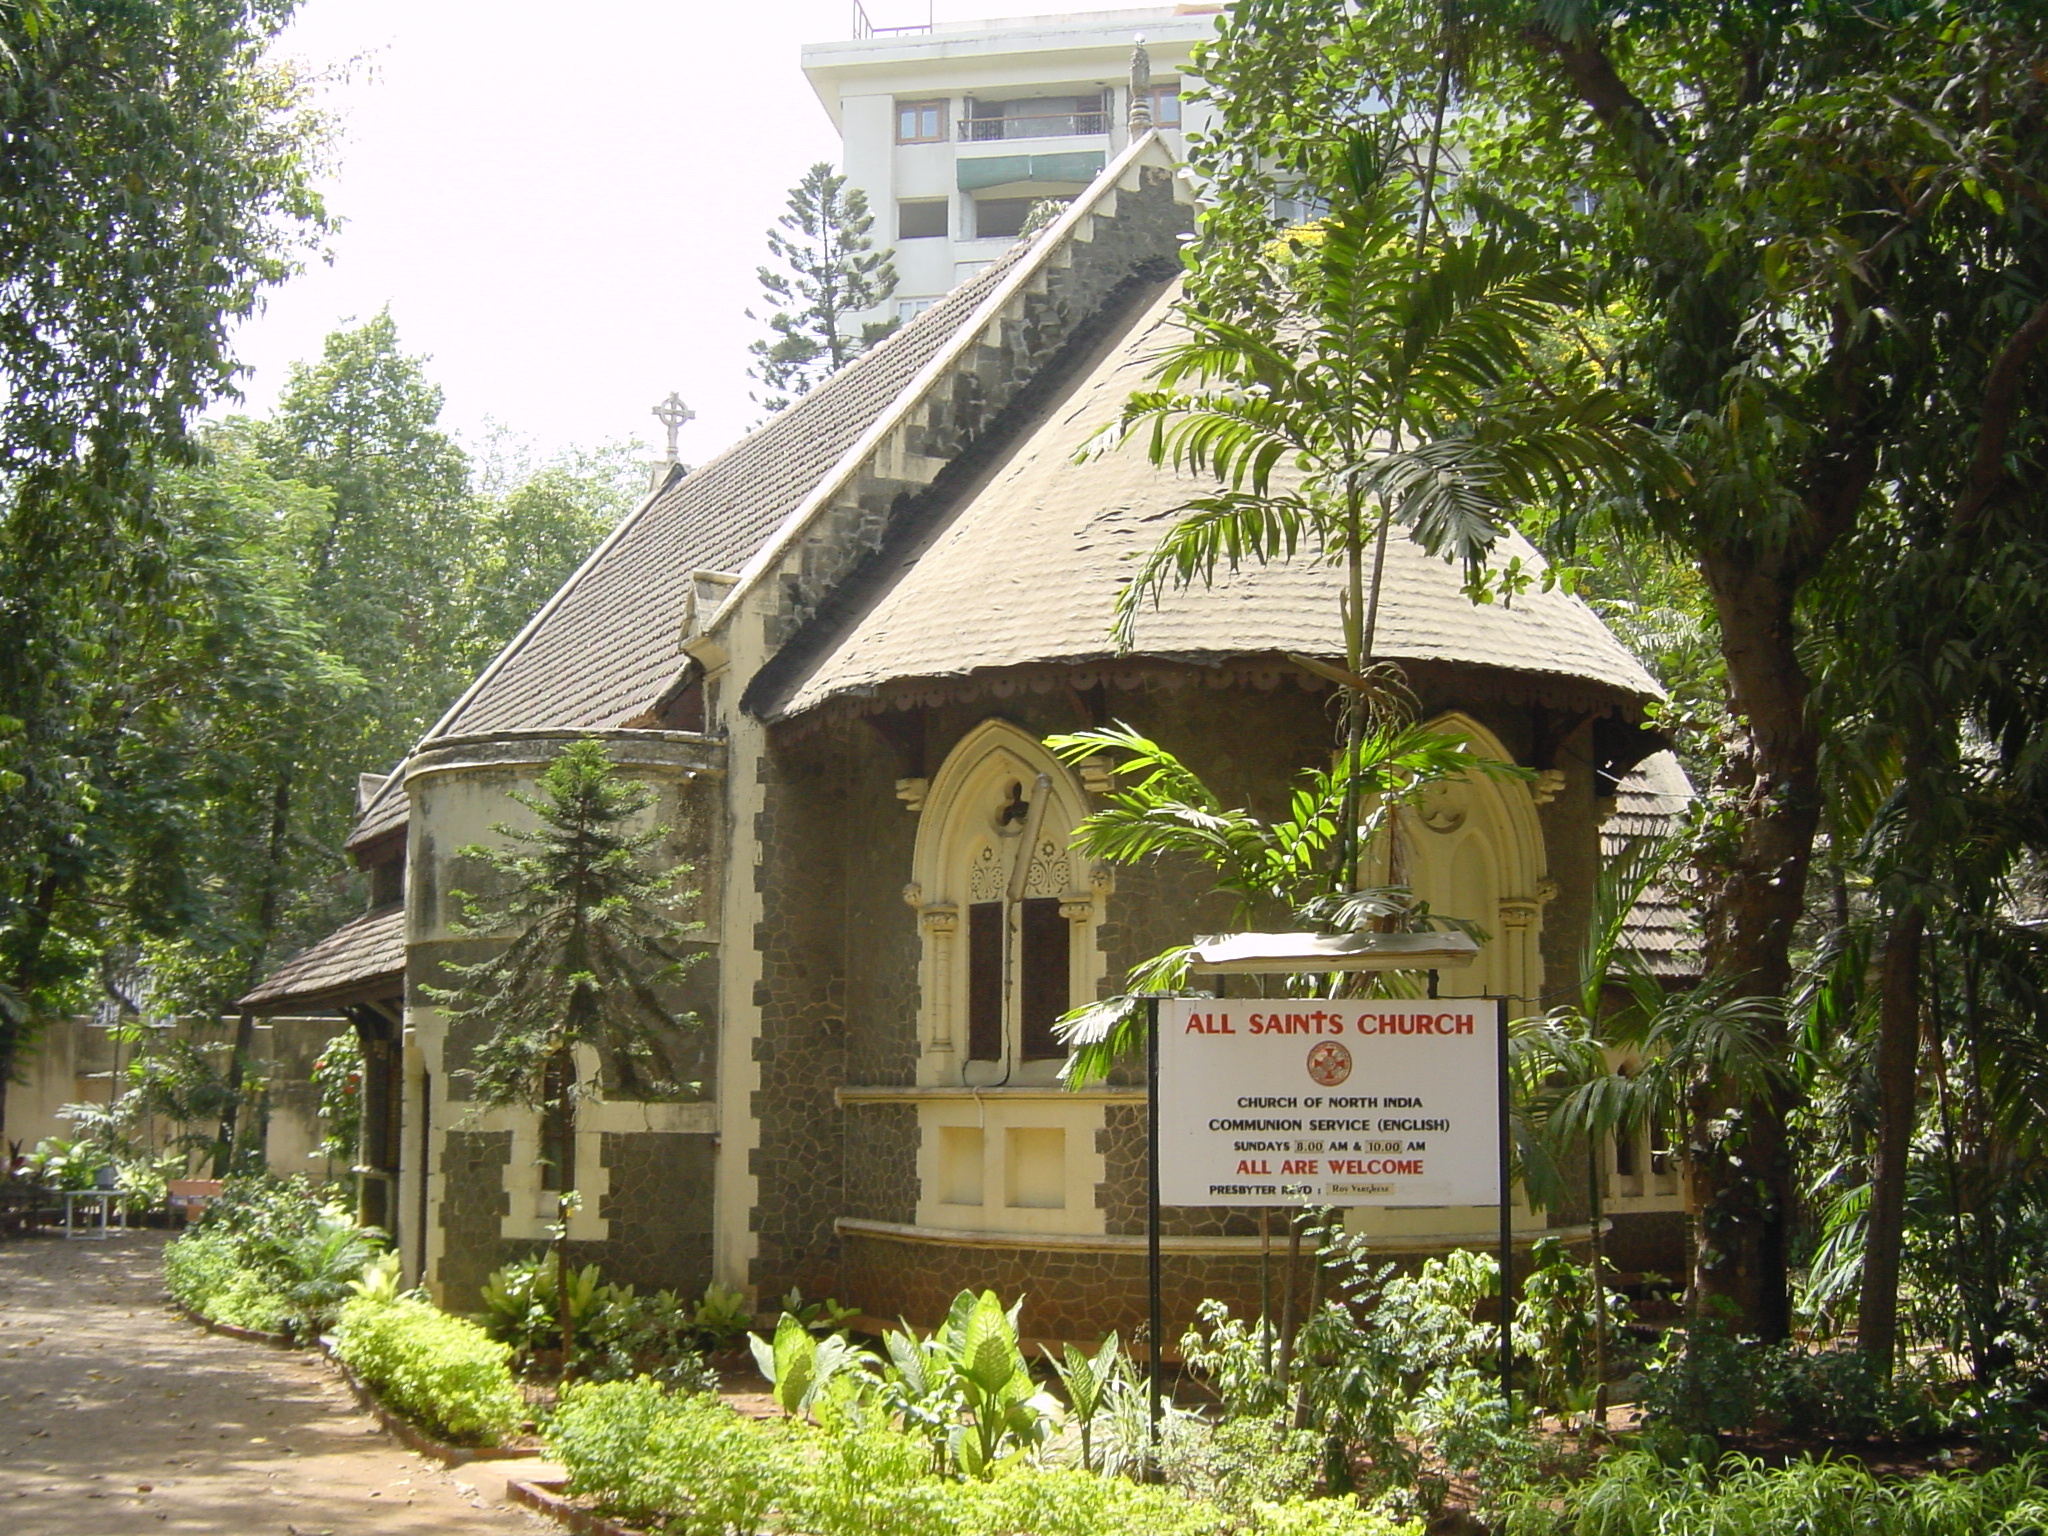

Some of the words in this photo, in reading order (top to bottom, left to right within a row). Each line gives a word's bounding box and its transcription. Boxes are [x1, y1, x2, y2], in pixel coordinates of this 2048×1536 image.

[1186, 1014, 1235, 1034] ALL
[1357, 1014, 1474, 1035] CHURCH
[1237, 1097, 1297, 1108] CHURCH
[1304, 1097, 1323, 1108] OF
[1329, 1097, 1378, 1108] NORTH
[1384, 1097, 1423, 1108] INDIA
[1209, 1119, 1302, 1131] COMMUNION
[1309, 1119, 1370, 1131] SERVICE
[1378, 1119, 1450, 1133] (ENGLISH)
[1234, 1141, 1290, 1151] SUNDAYS
[1296, 1141, 1323, 1152] 8.00
[1329, 1141, 1348, 1151] AM
[1353, 1141, 1361, 1151] &
[1369, 1142, 1400, 1152] 10.00
[1407, 1141, 1425, 1151] AM
[1236, 1160, 1272, 1175] ALL
[1281, 1160, 1318, 1175] ARE
[1328, 1160, 1424, 1175] WELCOME
[1209, 1185, 1276, 1195] PRESBYTER
